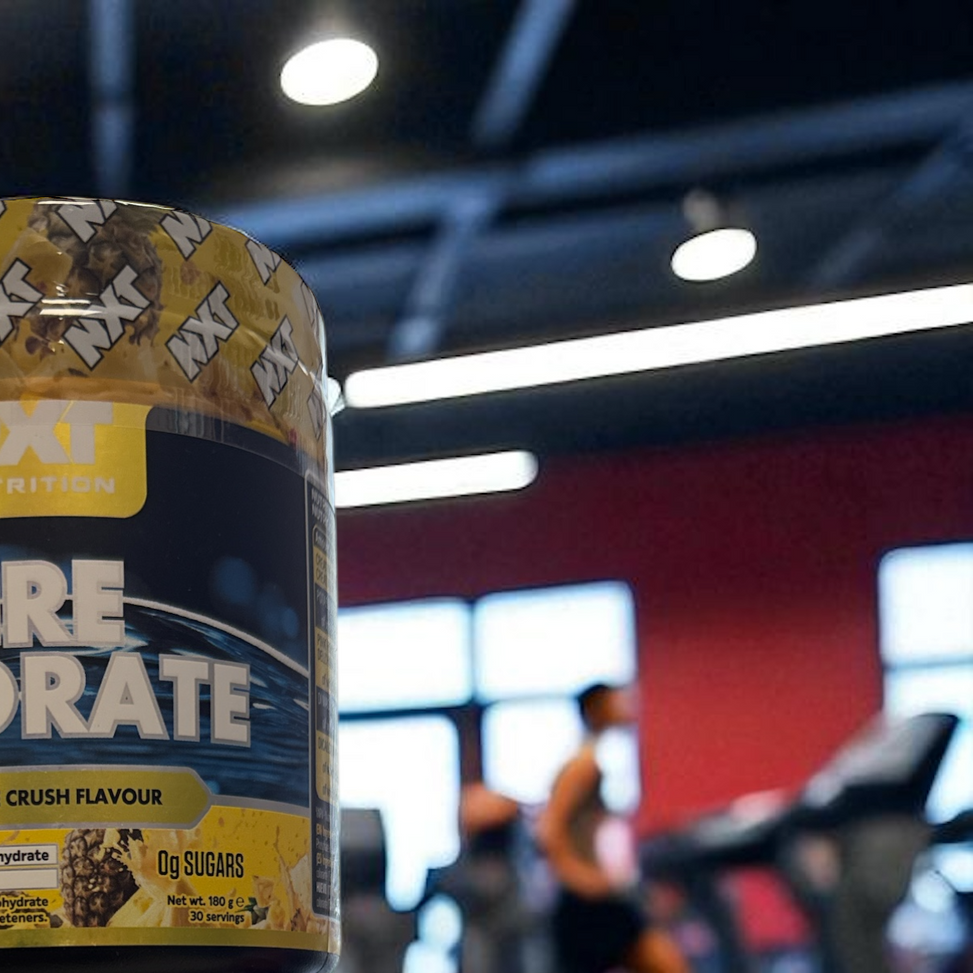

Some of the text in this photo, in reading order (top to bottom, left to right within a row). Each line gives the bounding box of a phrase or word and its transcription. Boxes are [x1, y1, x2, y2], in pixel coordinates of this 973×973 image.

[63, 263, 151, 371] NXT
[166, 281, 240, 383] NXT
[250, 314, 299, 410] NXT
[5, 788, 70, 807] CRUSH
[76, 788, 163, 805] FLAVOUR
[158, 850, 244, 880] 0g SUGARS
[167, 895, 234, 909] Net wt. 180 g
[190, 911, 244, 925] 30 servings
